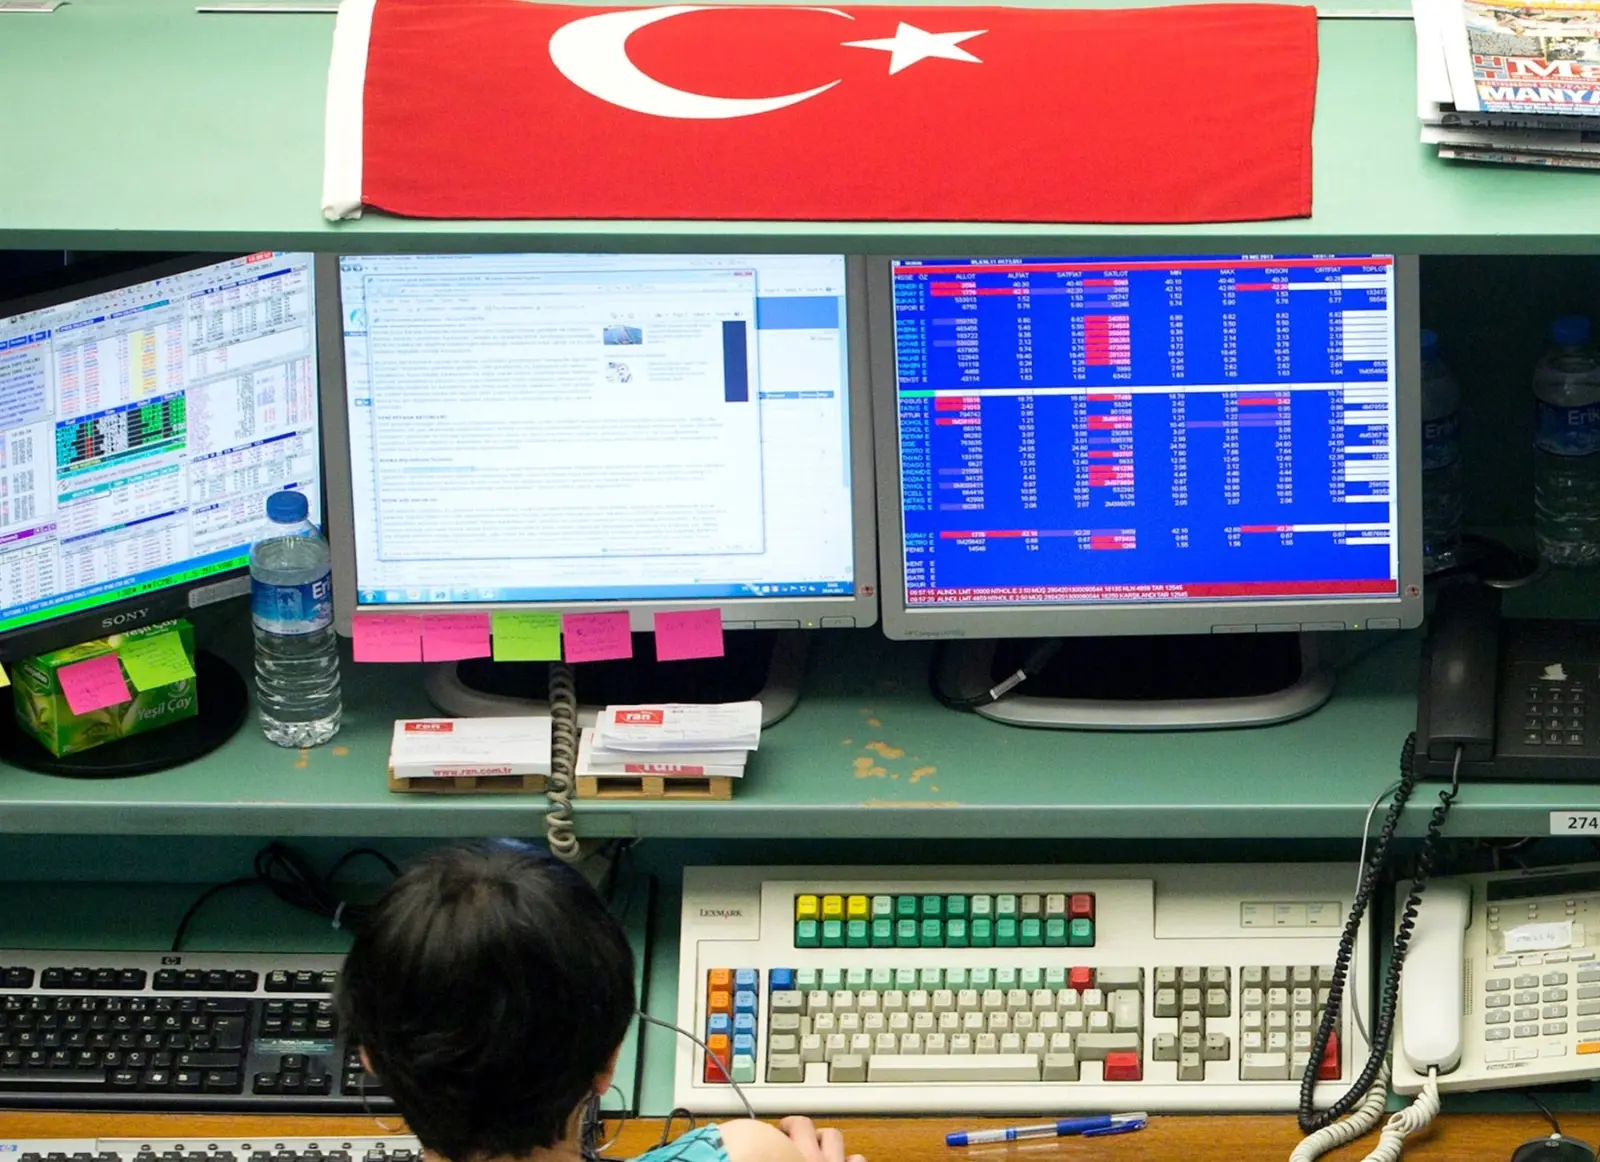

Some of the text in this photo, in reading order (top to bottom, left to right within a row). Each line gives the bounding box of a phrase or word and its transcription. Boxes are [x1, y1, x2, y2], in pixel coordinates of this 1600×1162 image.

[101, 608, 149, 629] SONY
[137, 695, 192, 720] Yeşil Çay
[626, 712, 651, 721] ran
[432, 767, 512, 776] www.ran.com.tr
[1567, 817, 1598, 829] 274
